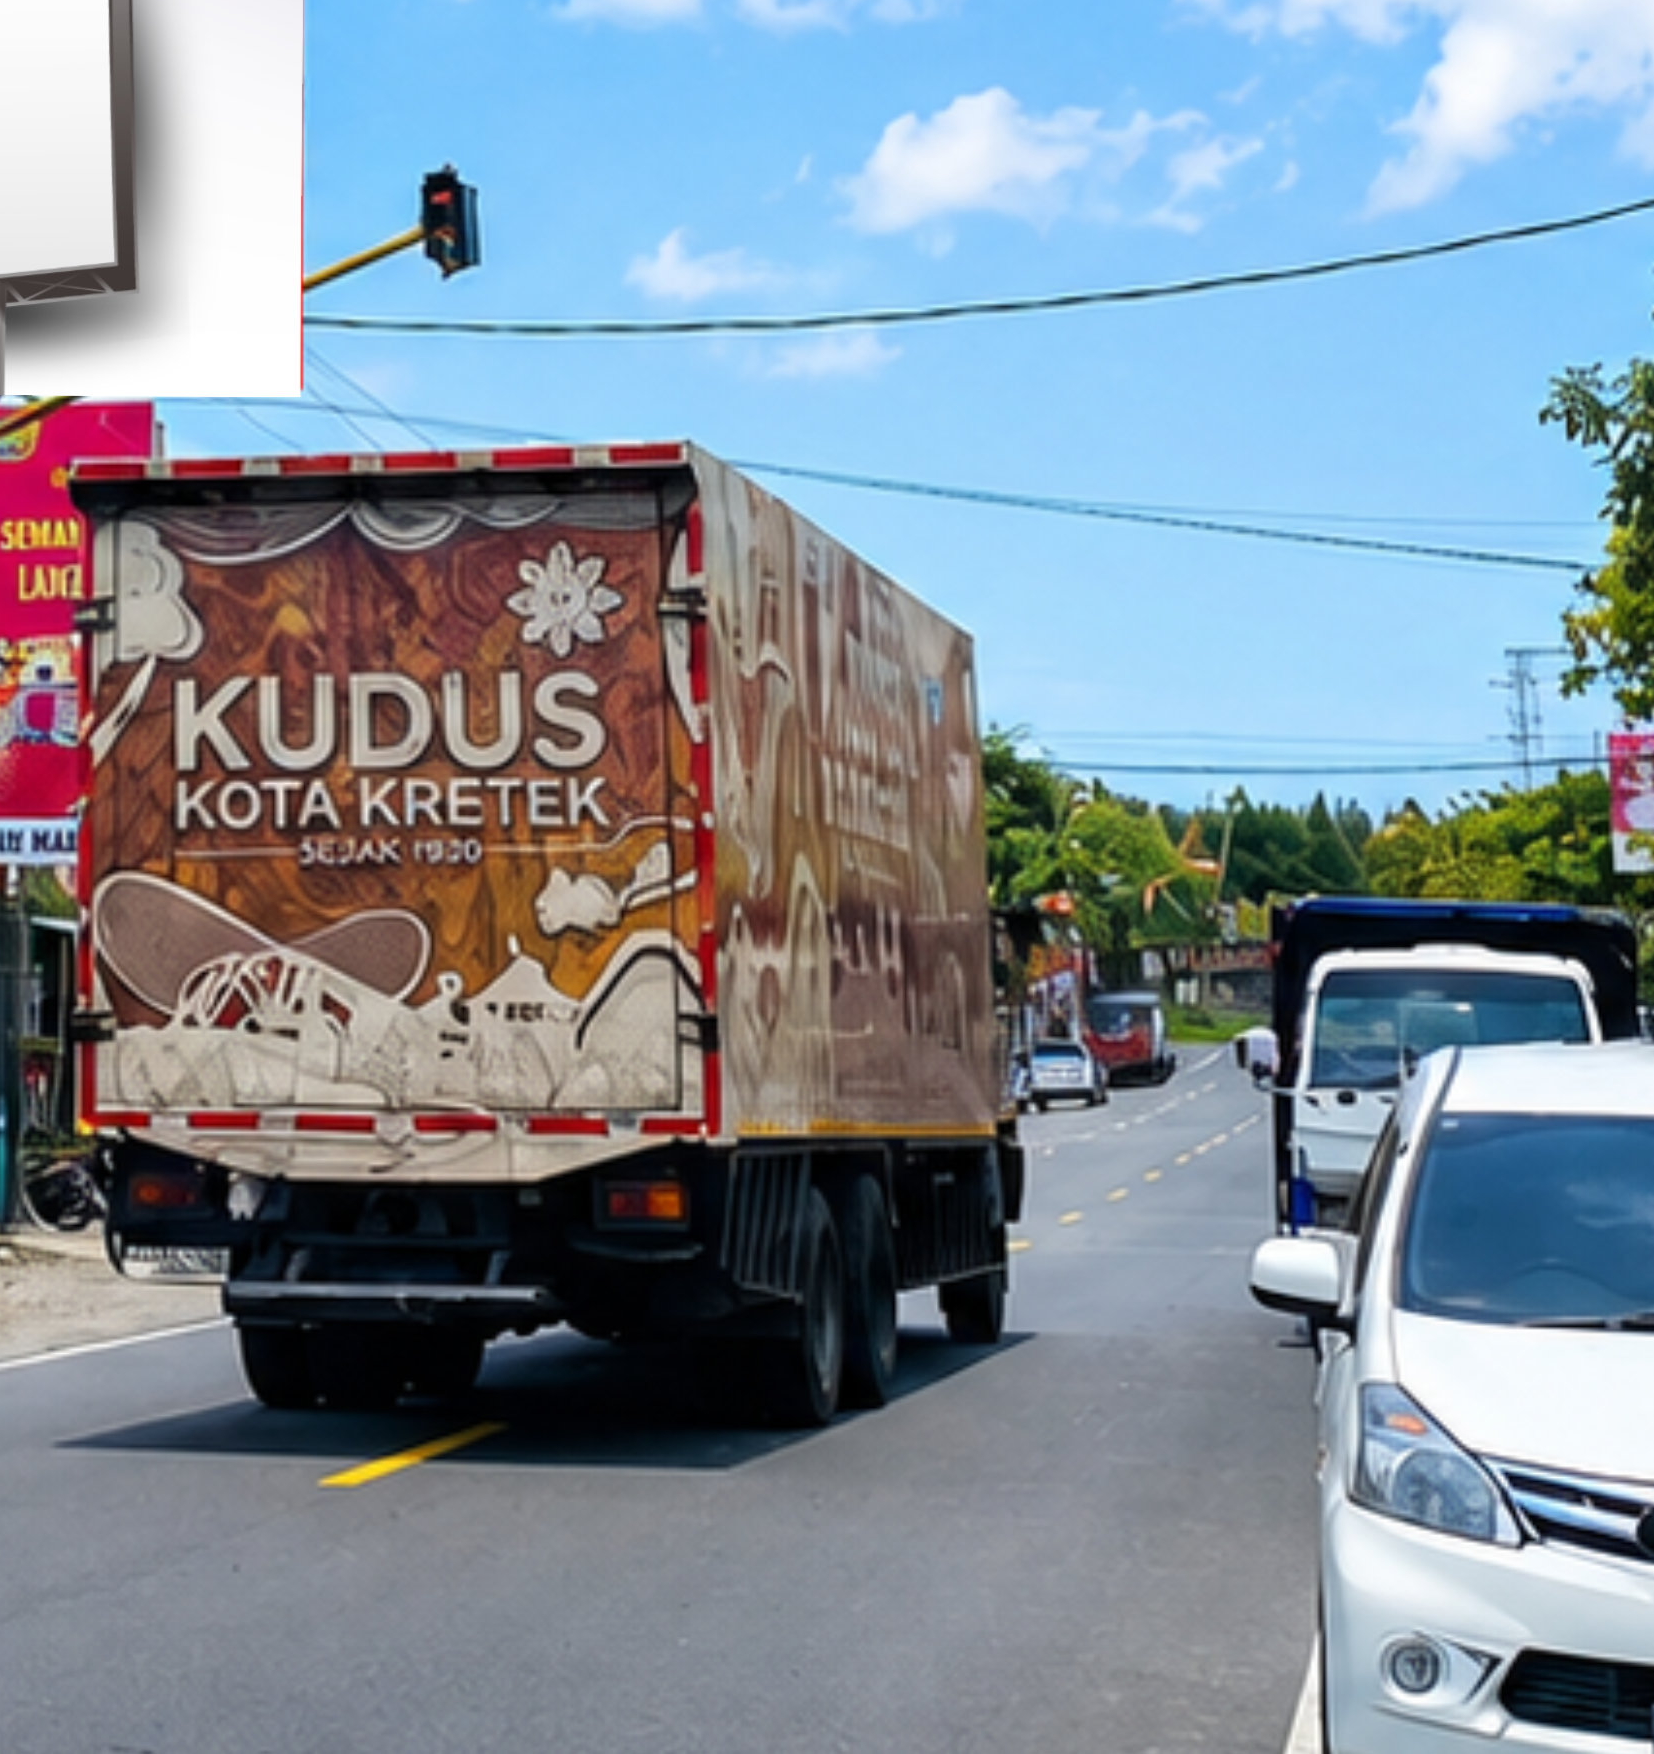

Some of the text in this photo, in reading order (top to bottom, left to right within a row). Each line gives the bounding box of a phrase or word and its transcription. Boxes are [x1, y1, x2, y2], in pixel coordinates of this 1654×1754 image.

[173, 669, 607, 771] KUDUS
[175, 775, 611, 830] KOTA KRETEK
